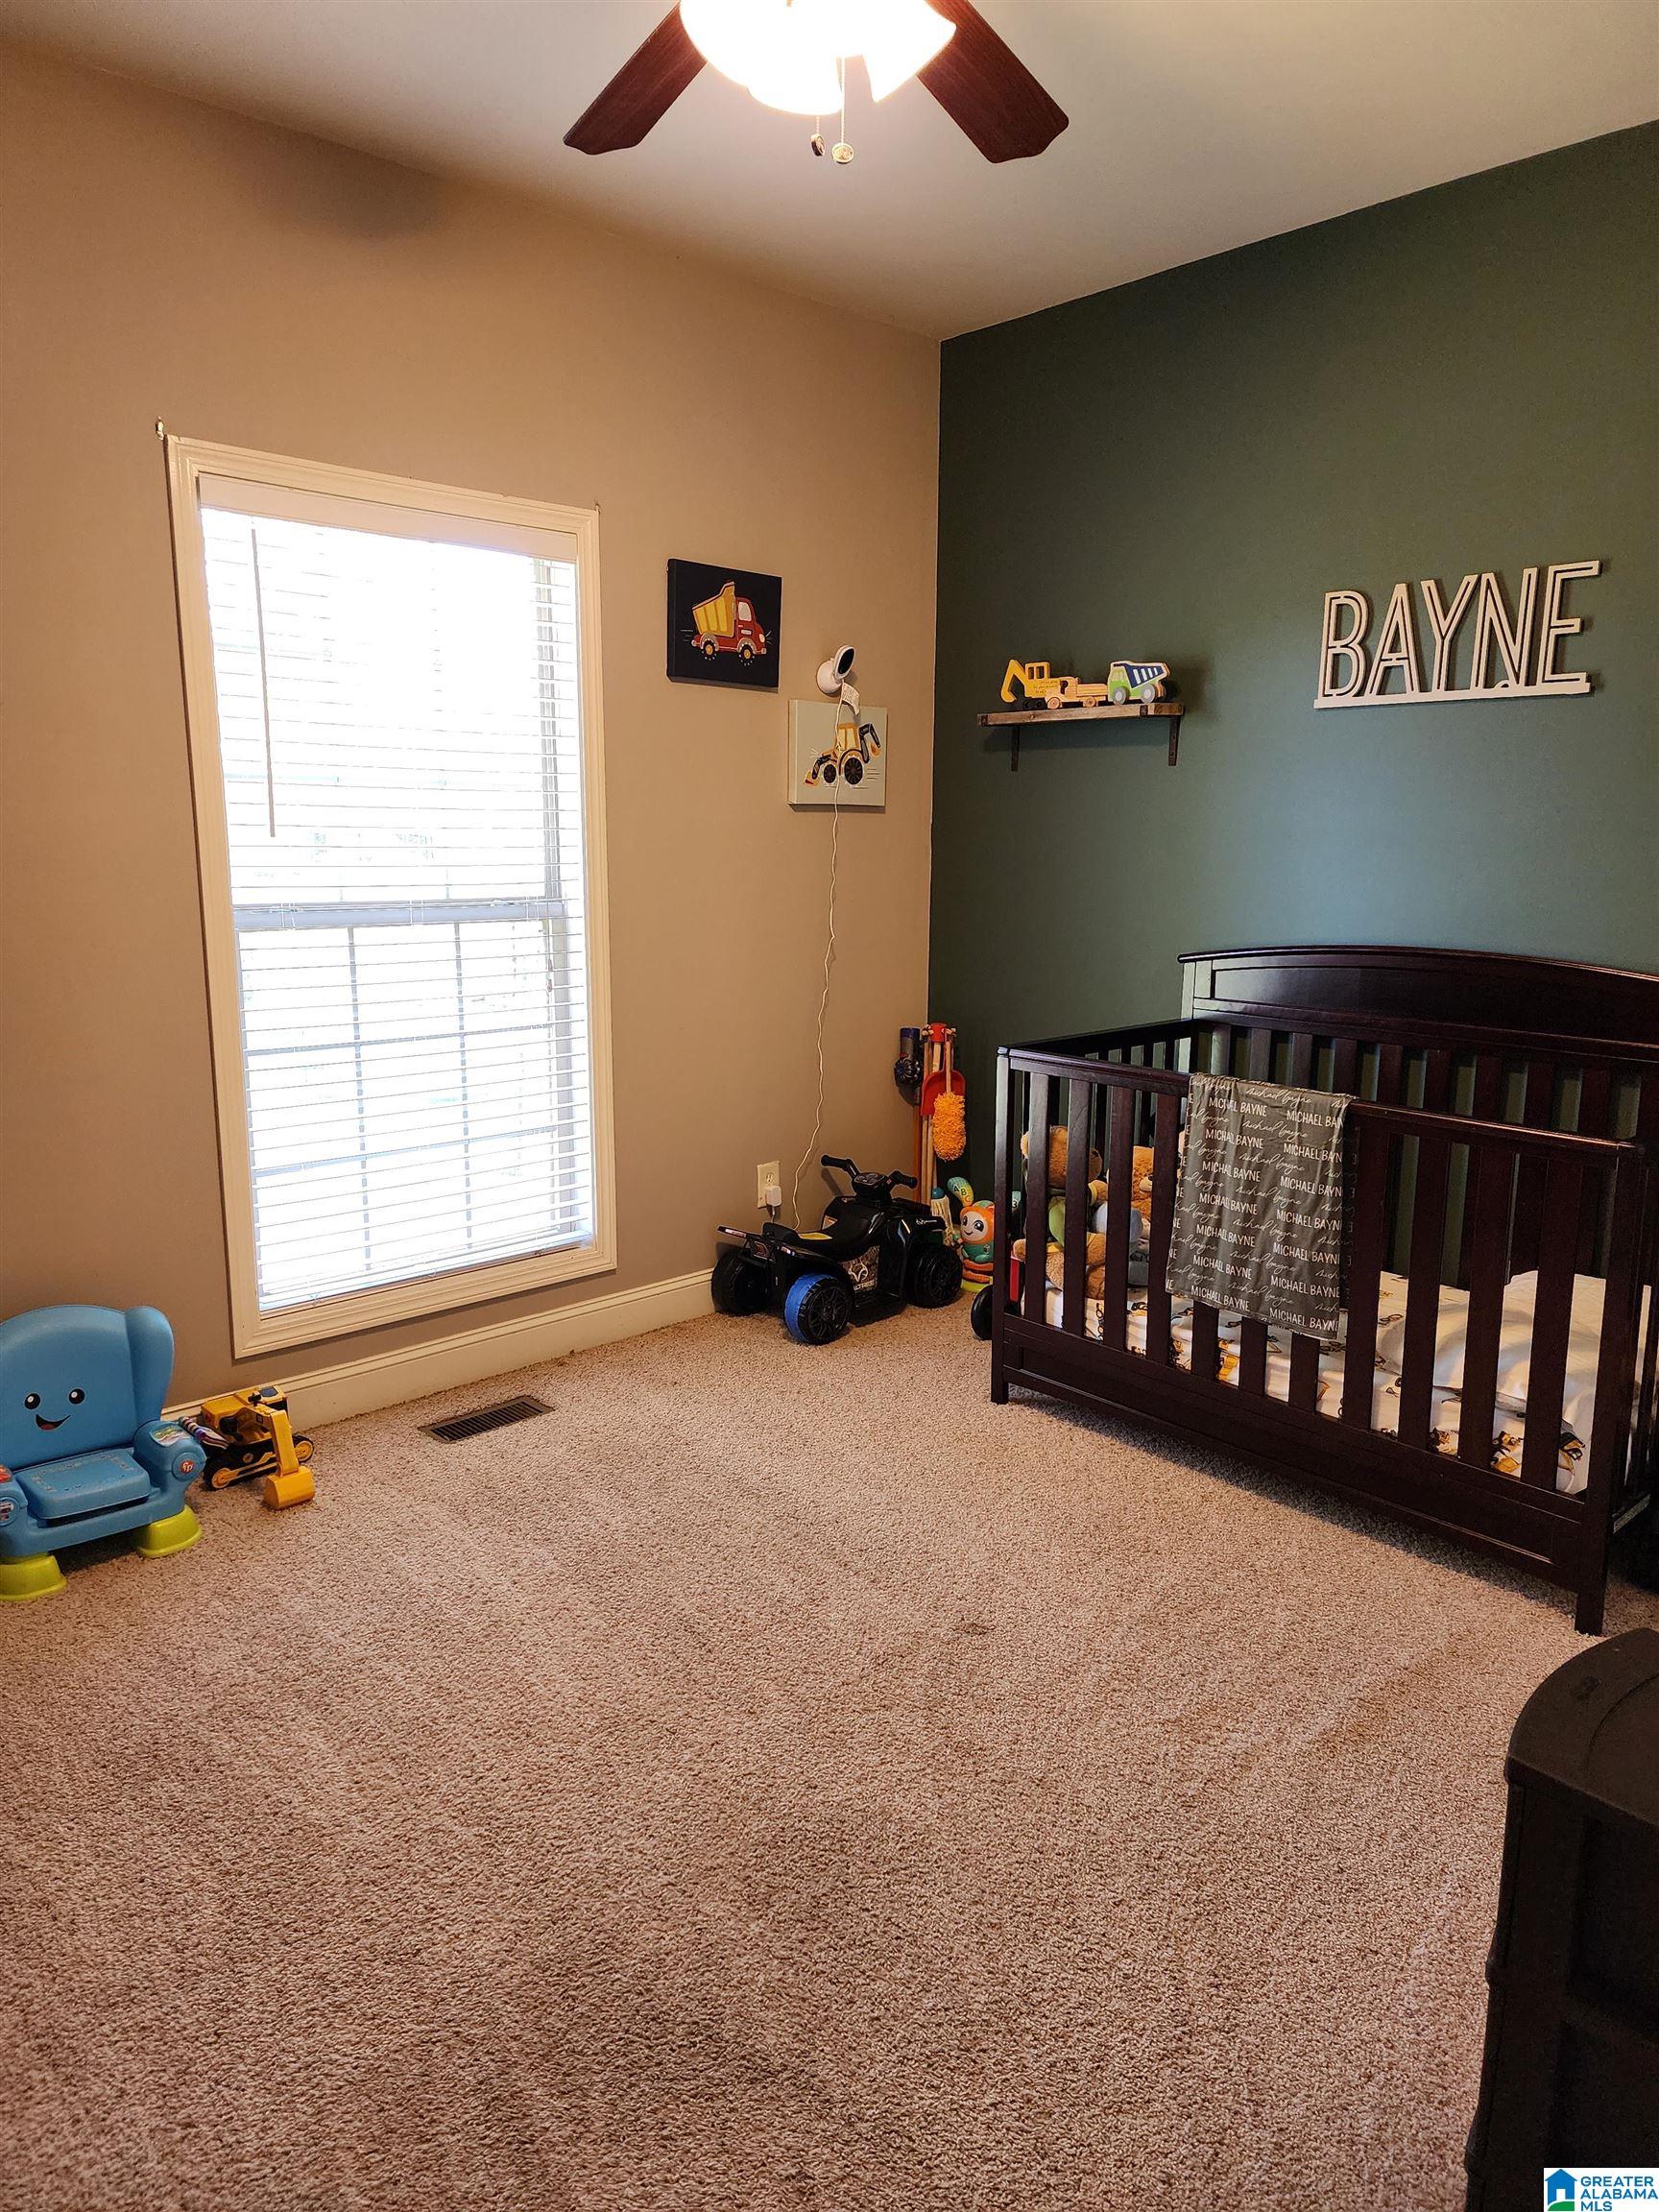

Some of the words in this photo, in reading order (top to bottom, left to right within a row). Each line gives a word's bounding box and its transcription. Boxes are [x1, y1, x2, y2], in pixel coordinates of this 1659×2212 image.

[1315, 560, 1600, 703] BAYNE
[1239, 1101, 1267, 1118] BAYNE
[1286, 1110, 1323, 1127] MICHAEL
[1205, 1129, 1235, 1145] MICHAL
[1236, 1134, 1263, 1149] BAYNE
[1284, 1142, 1320, 1161] MICHAEL
[1202, 1161, 1232, 1177] MICHAL
[1233, 1166, 1262, 1182] BAYNE
[1280, 1175, 1316, 1194] MICHAEL
[1230, 1199, 1258, 1215] BAYNE
[1276, 1209, 1312, 1228] MICHAEL
[1228, 1231, 1256, 1247] BAYNE
[1272, 1241, 1310, 1262] MICHAEL
[1225, 1262, 1252, 1280] BAYNE
[1270, 1275, 1308, 1294] MICHAEL
[1190, 1285, 1223, 1305] MICHAEL
[1223, 1295, 1252, 1312] BAYNE
[1269, 1307, 1307, 1327] MICHAEL
